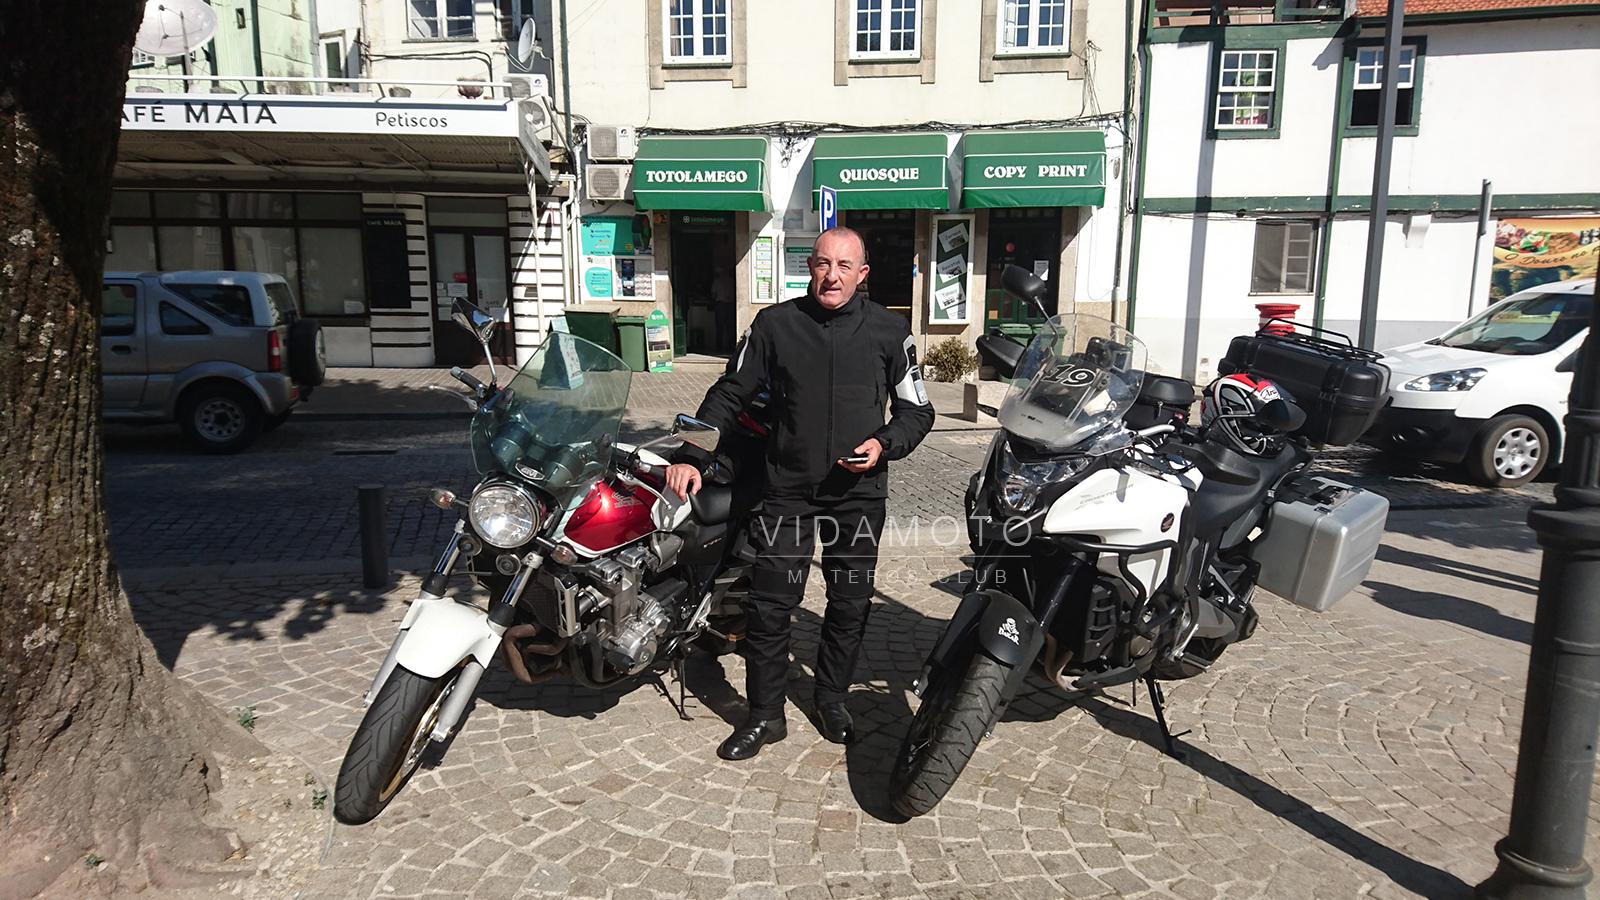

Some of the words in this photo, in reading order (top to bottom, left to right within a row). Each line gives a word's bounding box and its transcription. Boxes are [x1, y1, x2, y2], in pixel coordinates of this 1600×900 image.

[120, 100, 166, 123] AFÉ
[184, 102, 277, 124] MAIA
[375, 111, 448, 128] Petiscos
[645, 170, 748, 183] TOTOLAMEGO
[839, 167, 920, 184] QUIOSQUE
[983, 165, 1027, 178] COPY
[1037, 164, 1088, 177] PRINT
[823, 190, 834, 231] P
[1040, 363, 1097, 388] 19
